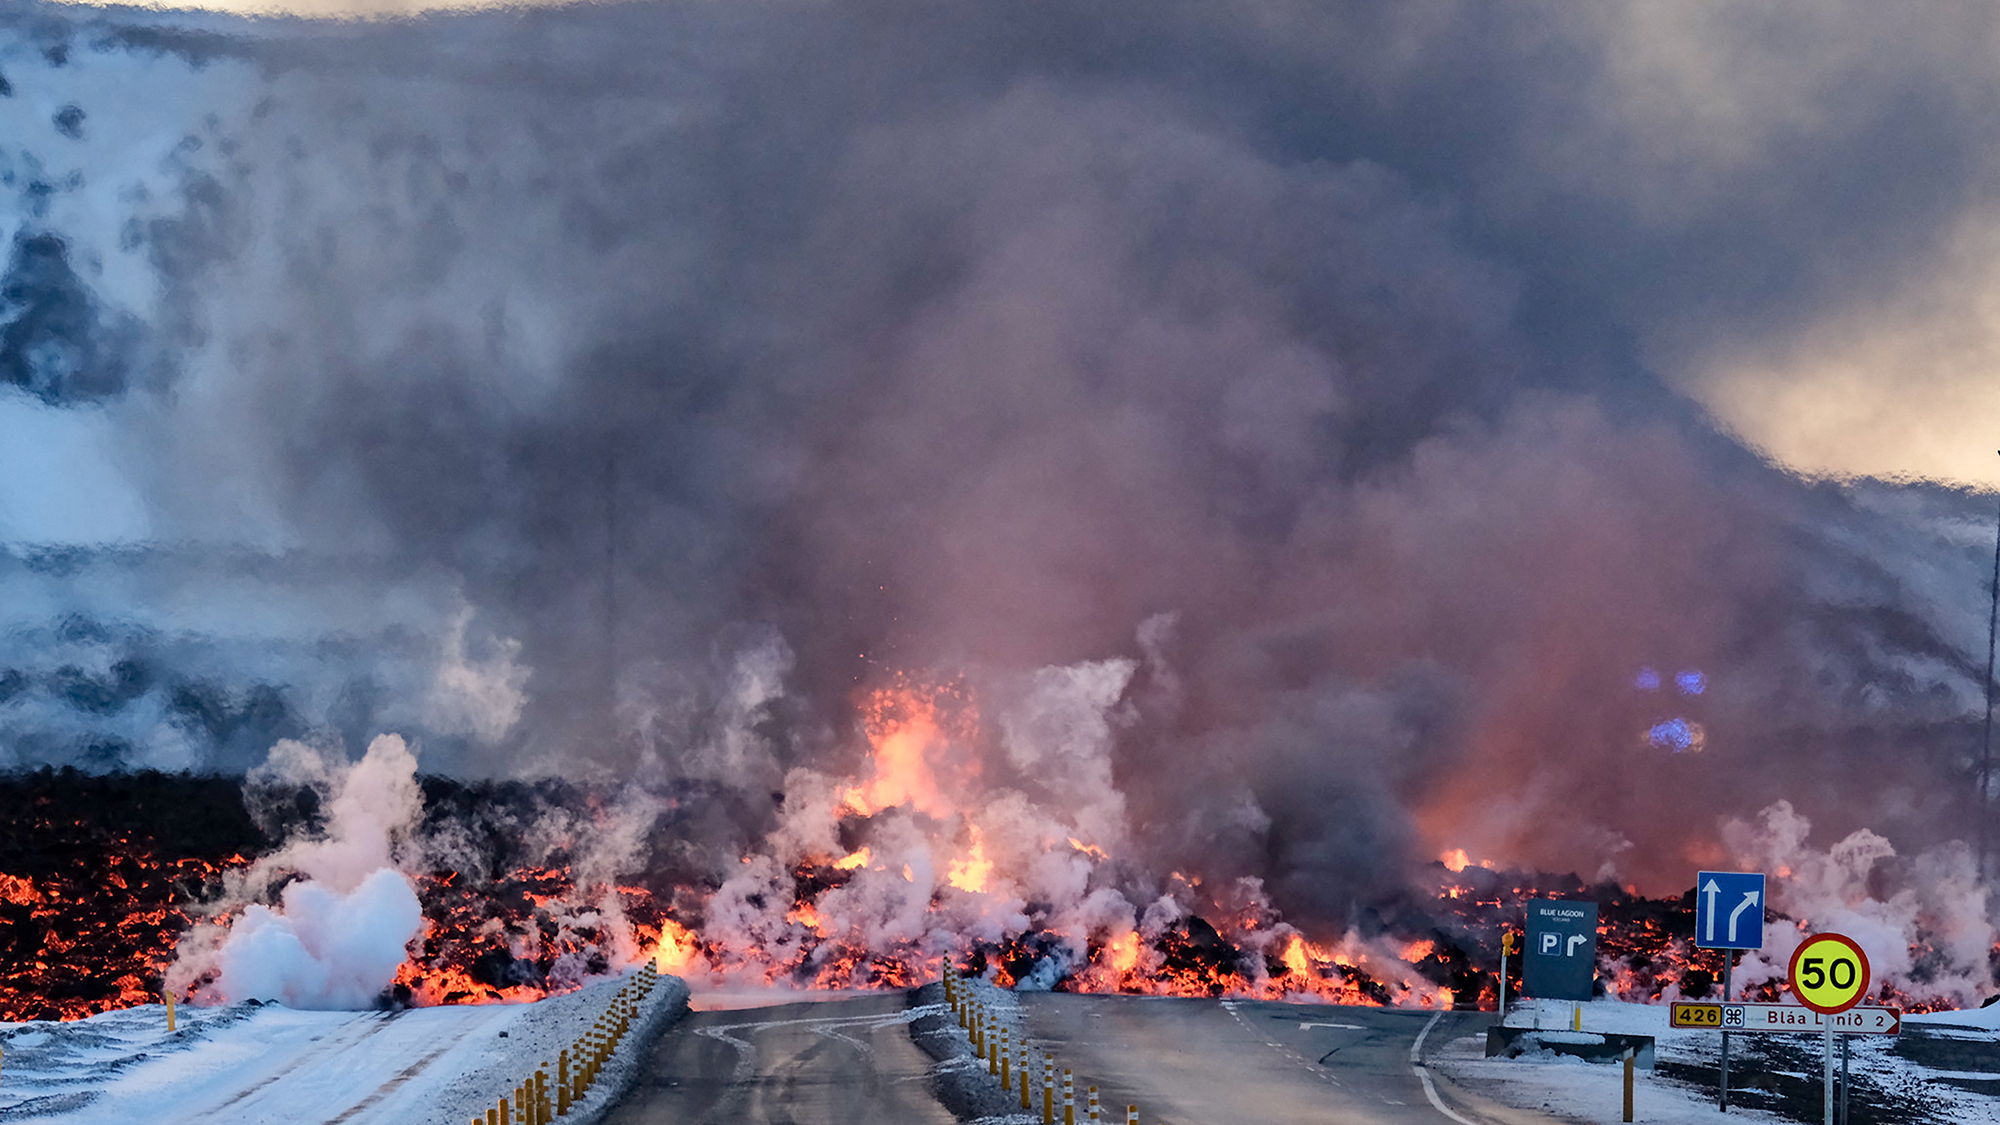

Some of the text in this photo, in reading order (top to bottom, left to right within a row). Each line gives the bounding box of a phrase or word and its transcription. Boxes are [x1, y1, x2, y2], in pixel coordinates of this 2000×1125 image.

[1540, 908, 1584, 918] BLUE LAGOON
[1543, 934, 1557, 953] P
[1802, 958, 1856, 989] 50
[1680, 1008, 1717, 1023] 426
[1767, 1010, 1806, 1024] Bláa
[1815, 1012, 1863, 1026] Lnið
[1875, 1016, 1885, 1027] 2
